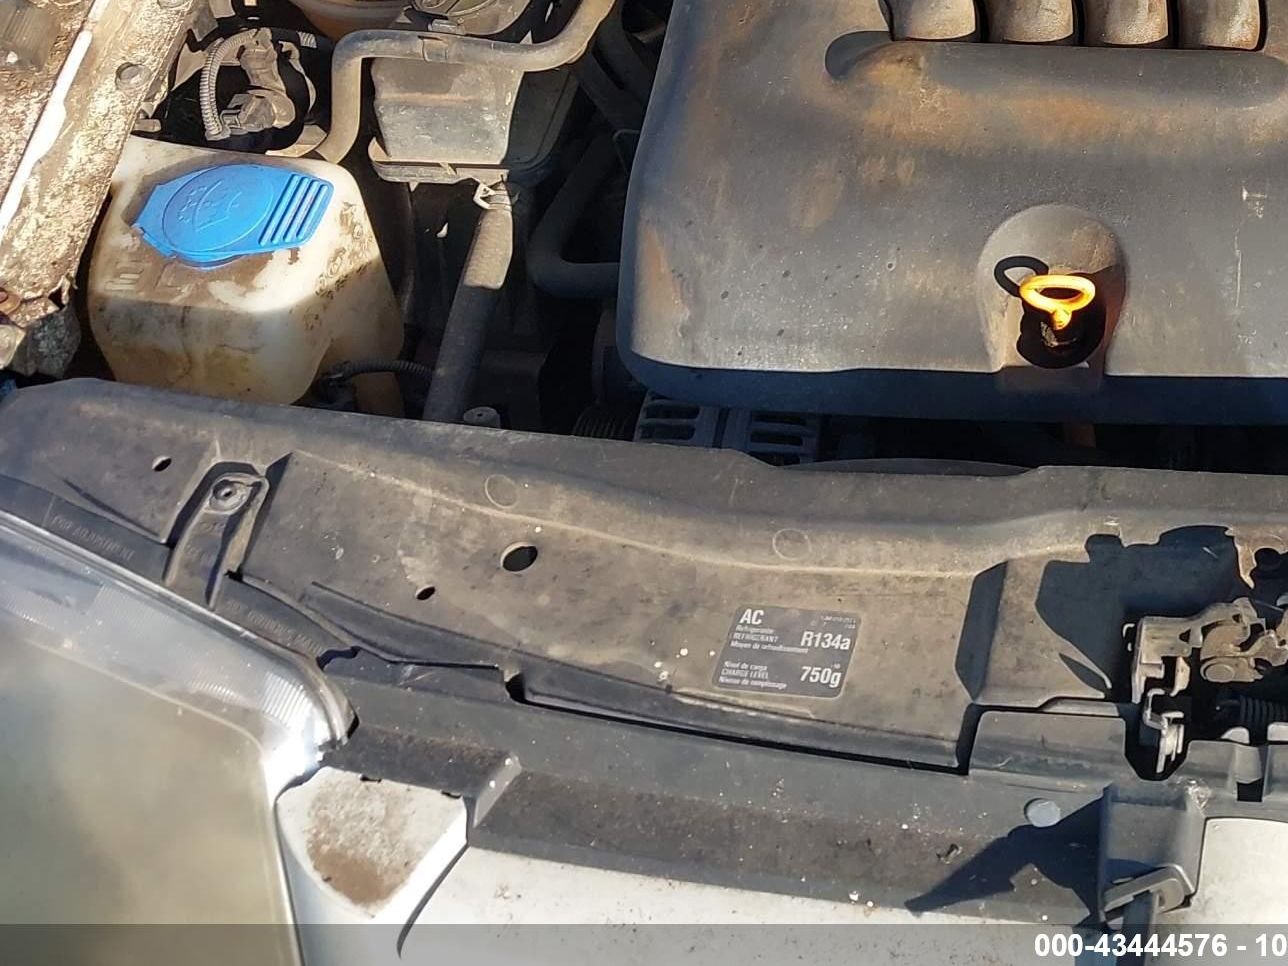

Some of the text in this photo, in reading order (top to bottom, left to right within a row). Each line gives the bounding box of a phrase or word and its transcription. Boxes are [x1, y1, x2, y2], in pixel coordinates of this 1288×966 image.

[740, 608, 764, 625] AC
[800, 631, 851, 651] R134a
[749, 671, 769, 680] LEVEL
[800, 666, 842, 689] 750g
